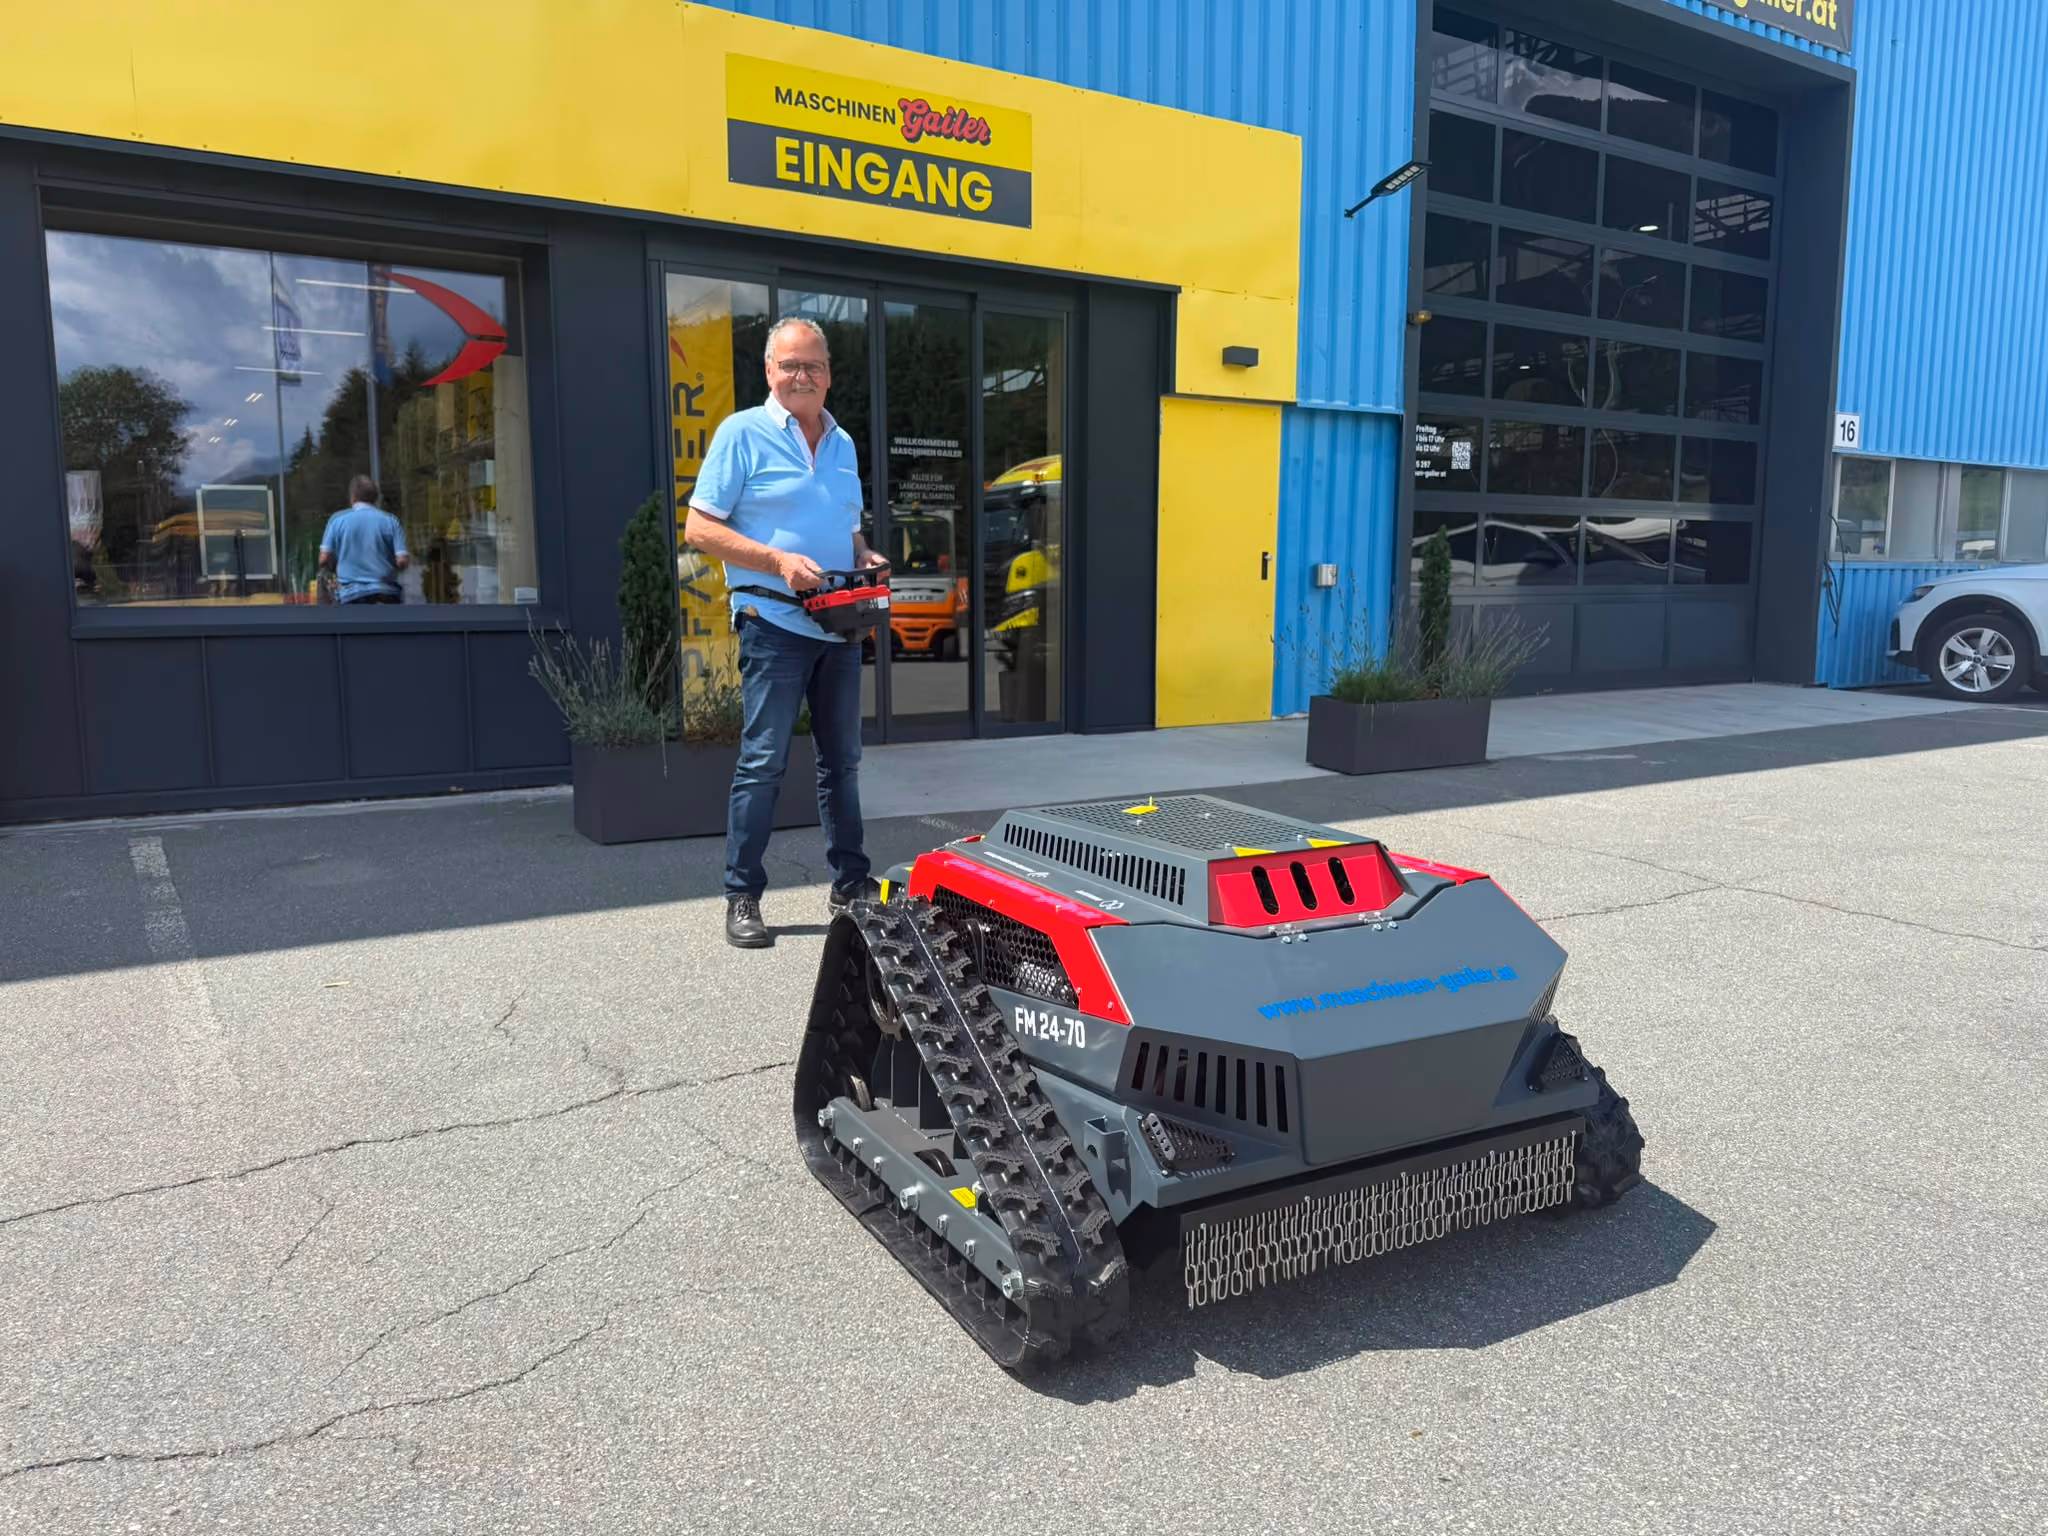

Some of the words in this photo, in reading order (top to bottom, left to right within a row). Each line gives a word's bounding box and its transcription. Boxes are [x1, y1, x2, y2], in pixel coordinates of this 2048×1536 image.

[774, 86, 896, 125] MASCHINEN
[898, 98, 991, 146] Gailer
[776, 136, 993, 212] EINGANG
[894, 437, 946, 448] WILLKOMMEN
[947, 440, 959, 448] BEI
[1415, 425, 1437, 435] Freitag
[1840, 420, 1856, 442] 16
[890, 447, 937, 457] MASCHINEN
[937, 449, 963, 458] GAILER
[1257, 965, 1519, 1020] www.maschinen-gailer.at
[1015, 1006, 1037, 1037] FM
[1039, 1012, 1086, 1049] 24-70
